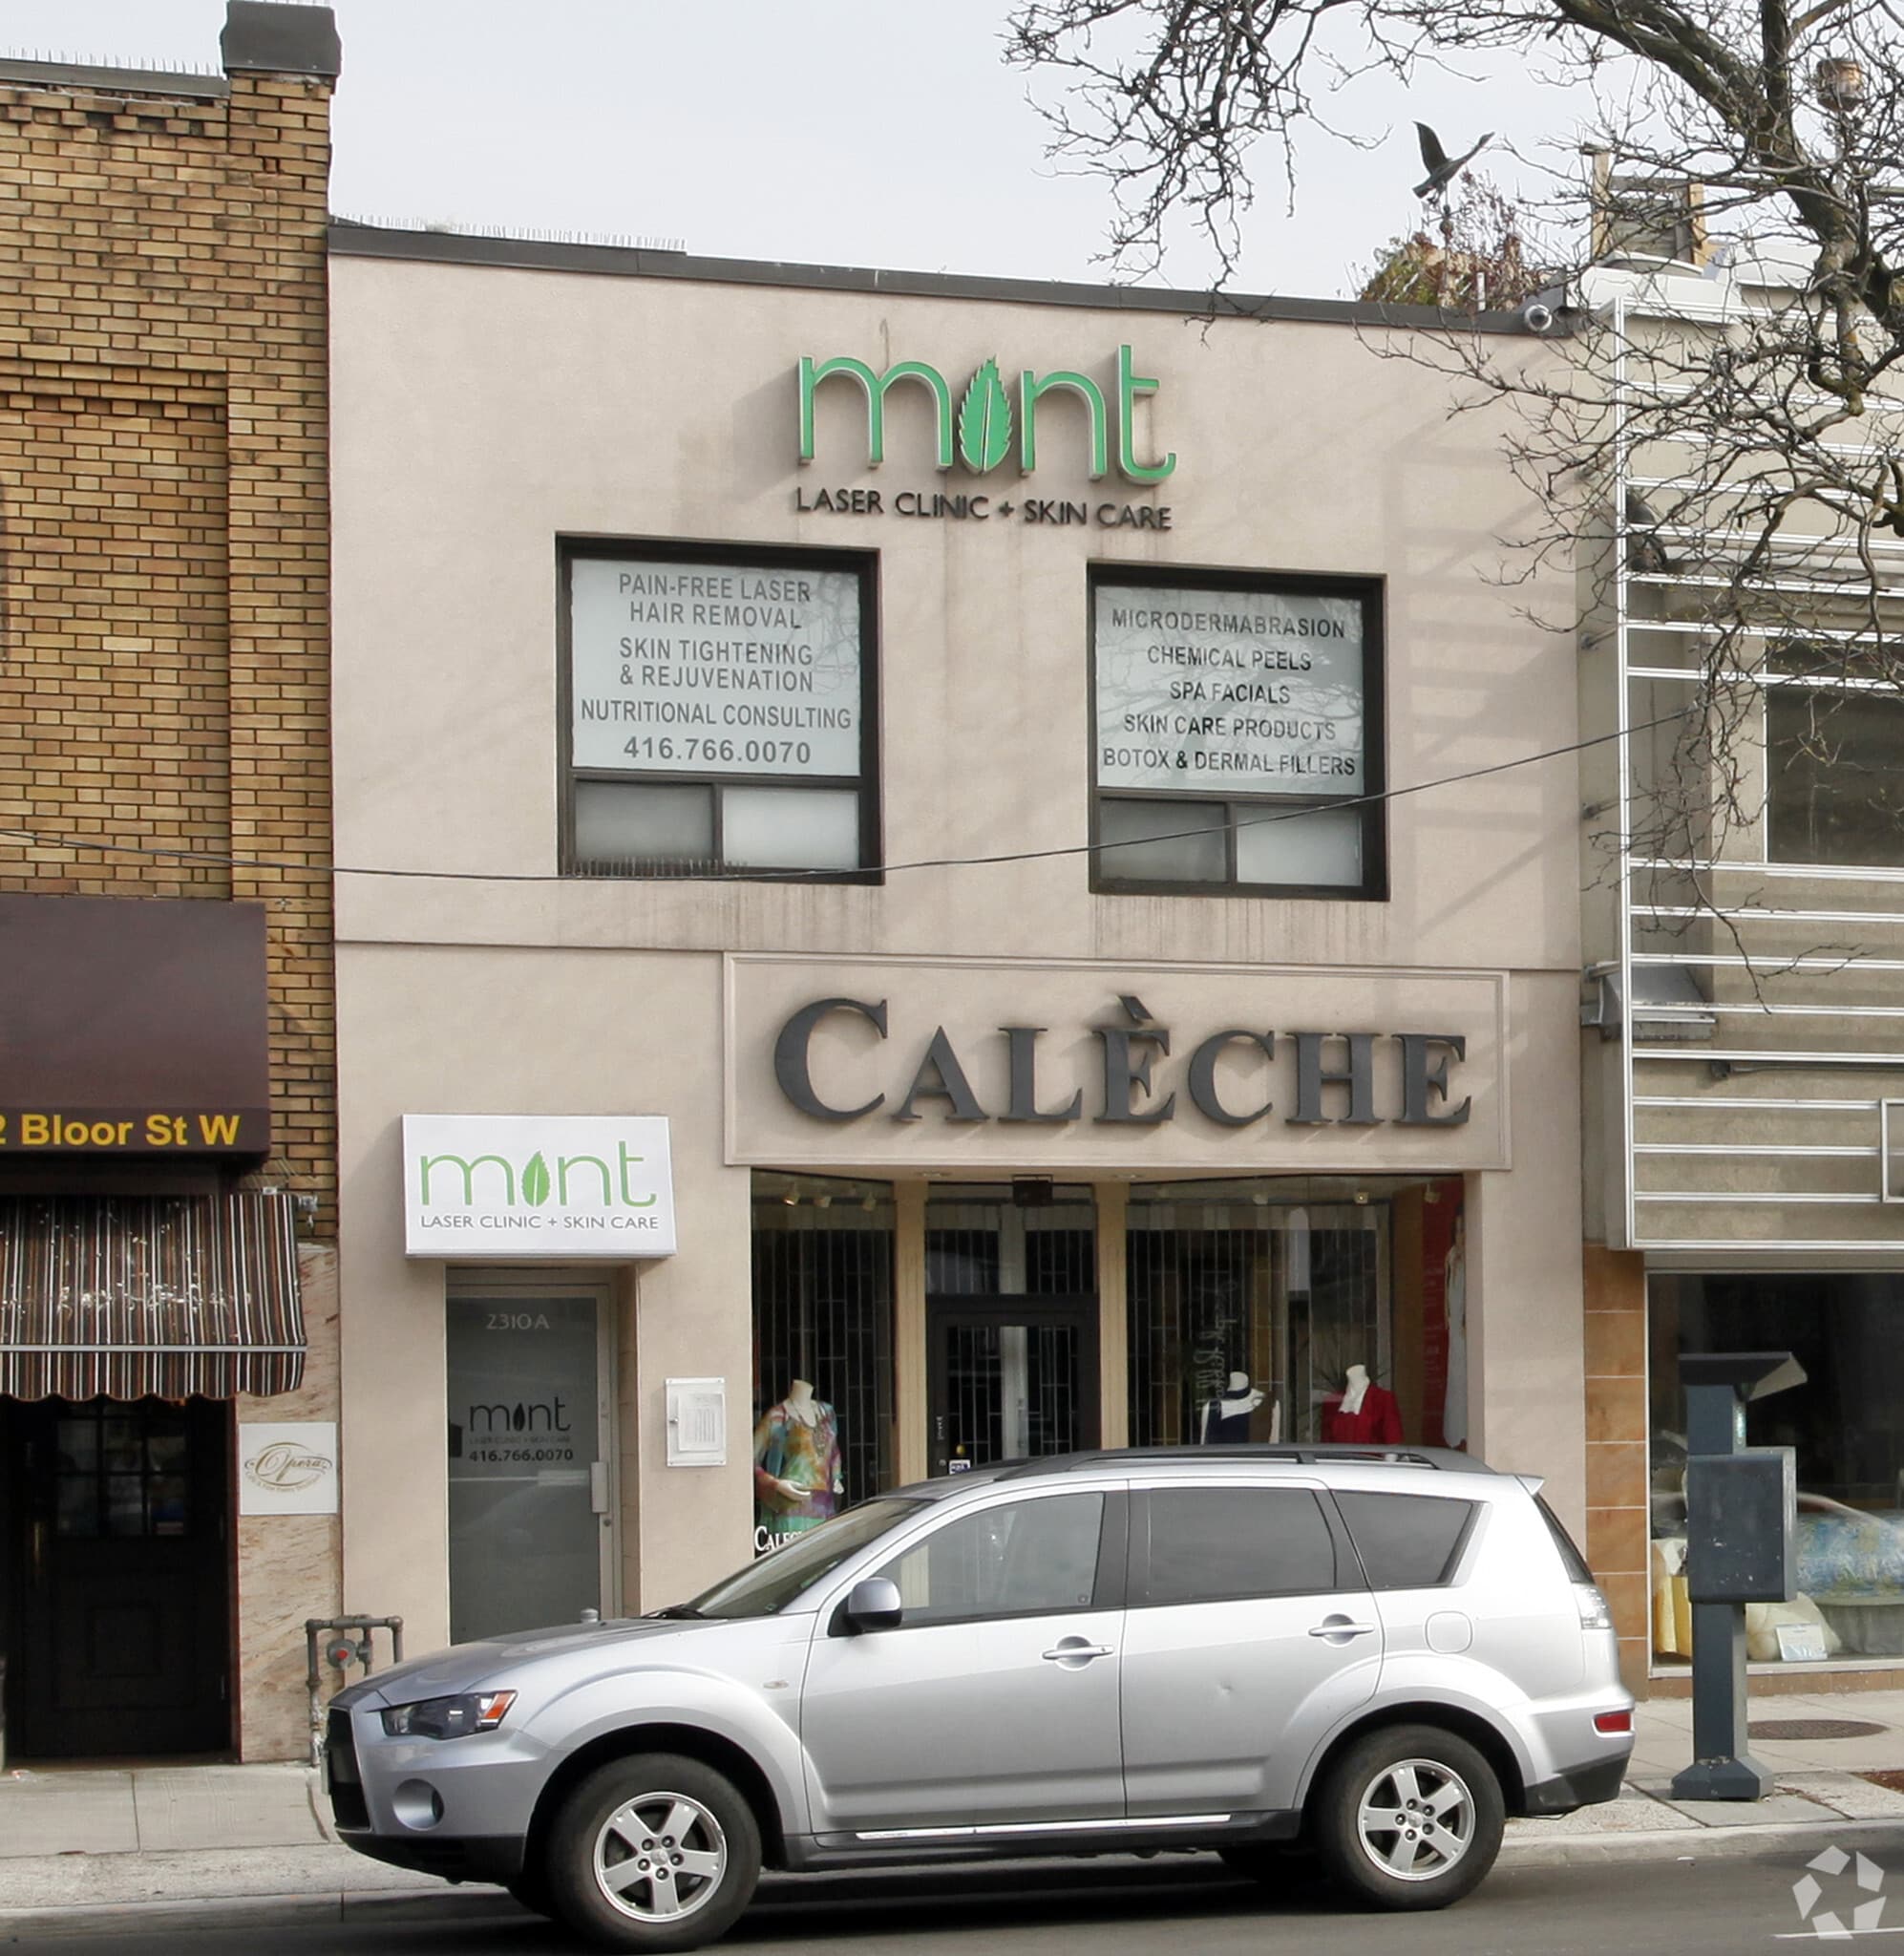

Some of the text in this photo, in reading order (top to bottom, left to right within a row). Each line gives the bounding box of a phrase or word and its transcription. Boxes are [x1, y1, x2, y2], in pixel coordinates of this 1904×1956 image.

[796, 486, 884, 514] LASER
[895, 492, 989, 520] CLINIC
[1023, 500, 1087, 525] SKIN
[1097, 502, 1172, 530] CARE
[620, 572, 811, 603] PAIN-FREE LASER
[630, 602, 801, 629] HAIR REMOVAL
[1112, 608, 1344, 638] MICRODERMABRASION
[621, 637, 813, 666] SKIN TIGHTENING
[1148, 646, 1312, 671] CHEMICAL PEELS
[621, 665, 813, 691] & REJUVENATION
[1170, 681, 1291, 704] SPA FACIALS
[581, 699, 852, 729] NUTRITIONAL CONSULTING
[1124, 714, 1337, 741] SKIN CARE PRODUCTS
[624, 736, 812, 764] 416.766.0070
[1103, 748, 1356, 776] BOTOX & DERMAL FILLERS
[773, 995, 1471, 1125] CALÈCHE
[21, 1114, 134, 1146] Bloor
[145, 1114, 188, 1146] St
[199, 1115, 241, 1146] W
[420, 1216, 475, 1228] LASER
[479, 1216, 541, 1229] CLINIC
[563, 1216, 605, 1229] SKIN
[610, 1217, 659, 1229] CARE
[486, 1313, 550, 1330] 2310A
[255, 1446, 322, 1483] Opera
[469, 1448, 574, 1463] 416.766.0070
[754, 1525, 802, 1552] CALE
